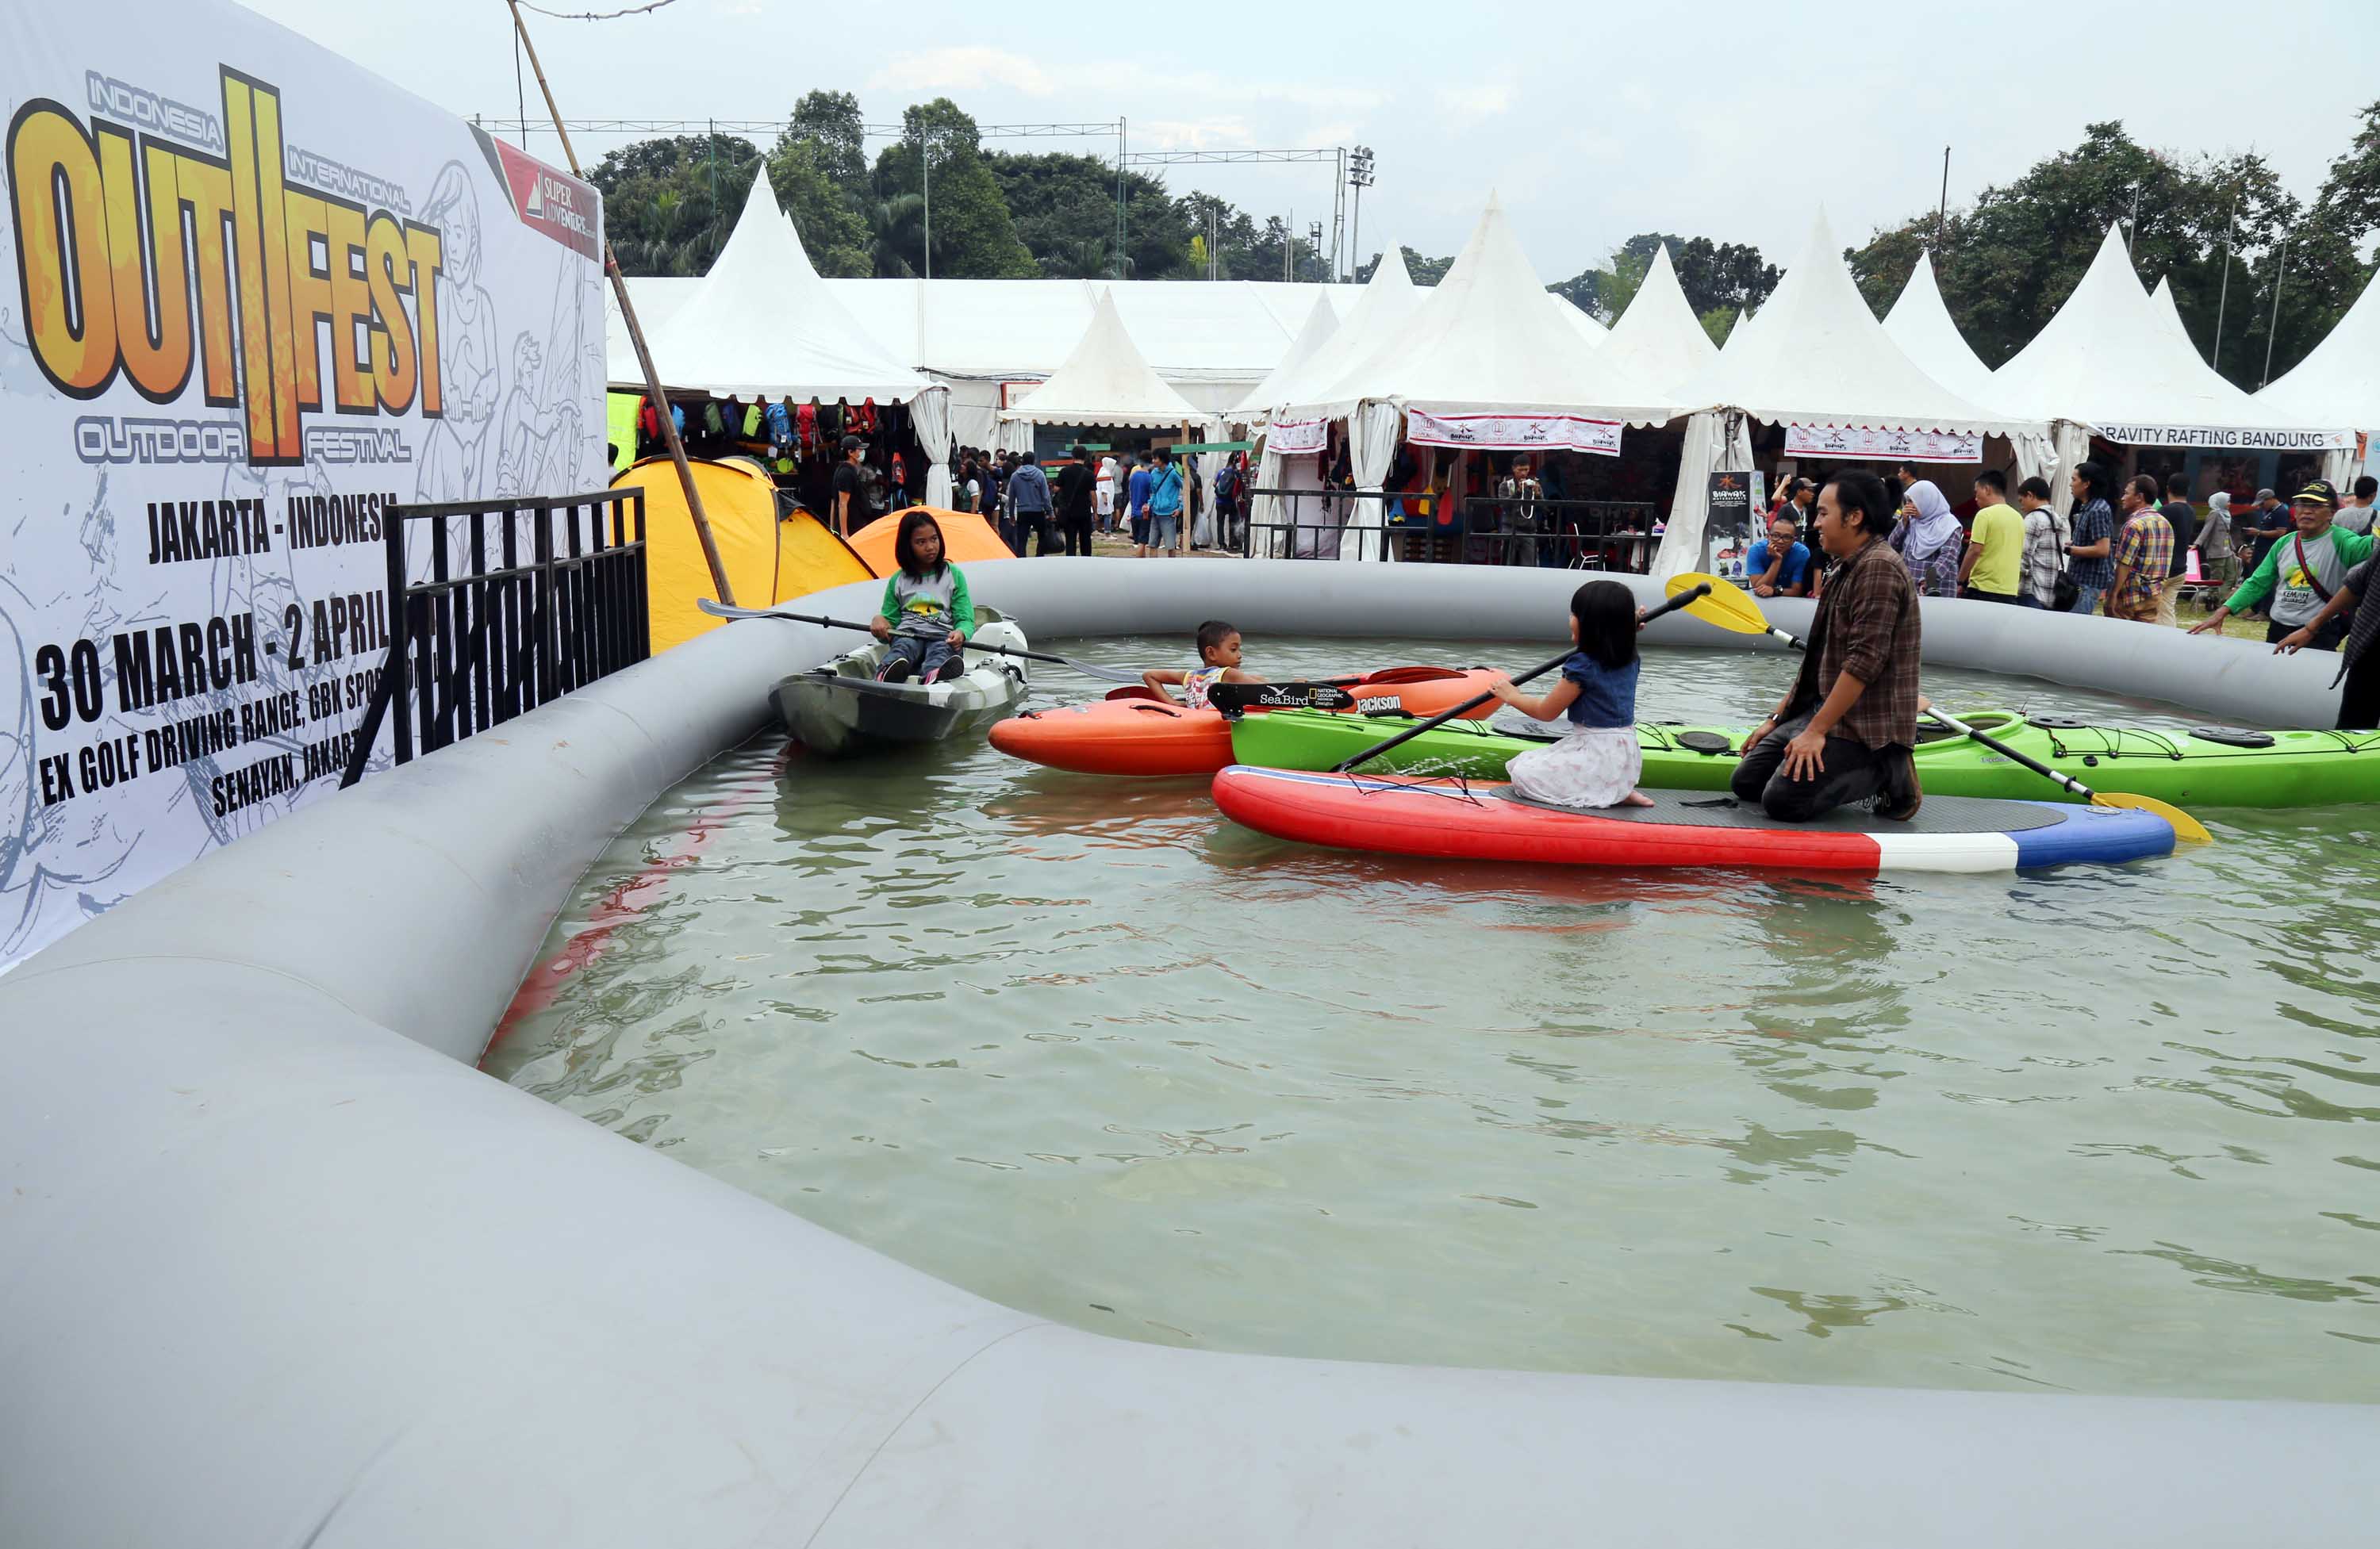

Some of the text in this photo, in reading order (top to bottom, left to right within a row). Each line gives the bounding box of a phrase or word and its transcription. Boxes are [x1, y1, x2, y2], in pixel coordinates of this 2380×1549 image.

[87, 73, 223, 149] INDONESIA
[289, 148, 411, 213] INTERNATIONAL
[544, 177, 572, 208] SUPER
[545, 202, 586, 236] ADVENTURE
[76, 418, 245, 461] OUTDOOR
[306, 427, 411, 461] FESTIVAL
[2167, 428, 2237, 445] RAFTING
[2242, 431, 2324, 447] BANDUNG
[147, 499, 271, 565] JAKARTA
[287, 493, 397, 550] INDONESI
[36, 638, 103, 731] 30
[113, 612, 258, 713] MARCH
[284, 604, 305, 672] 2
[313, 589, 390, 665] APRIL
[39, 752, 75, 807] EX
[79, 734, 140, 794] GOLF
[144, 707, 237, 774] DRIVING
[240, 689, 305, 745] RANGE,
[308, 677, 344, 723] GBK
[345, 666, 385, 711] SPO
[211, 728, 361, 819] SENAYAN, JAKAR
